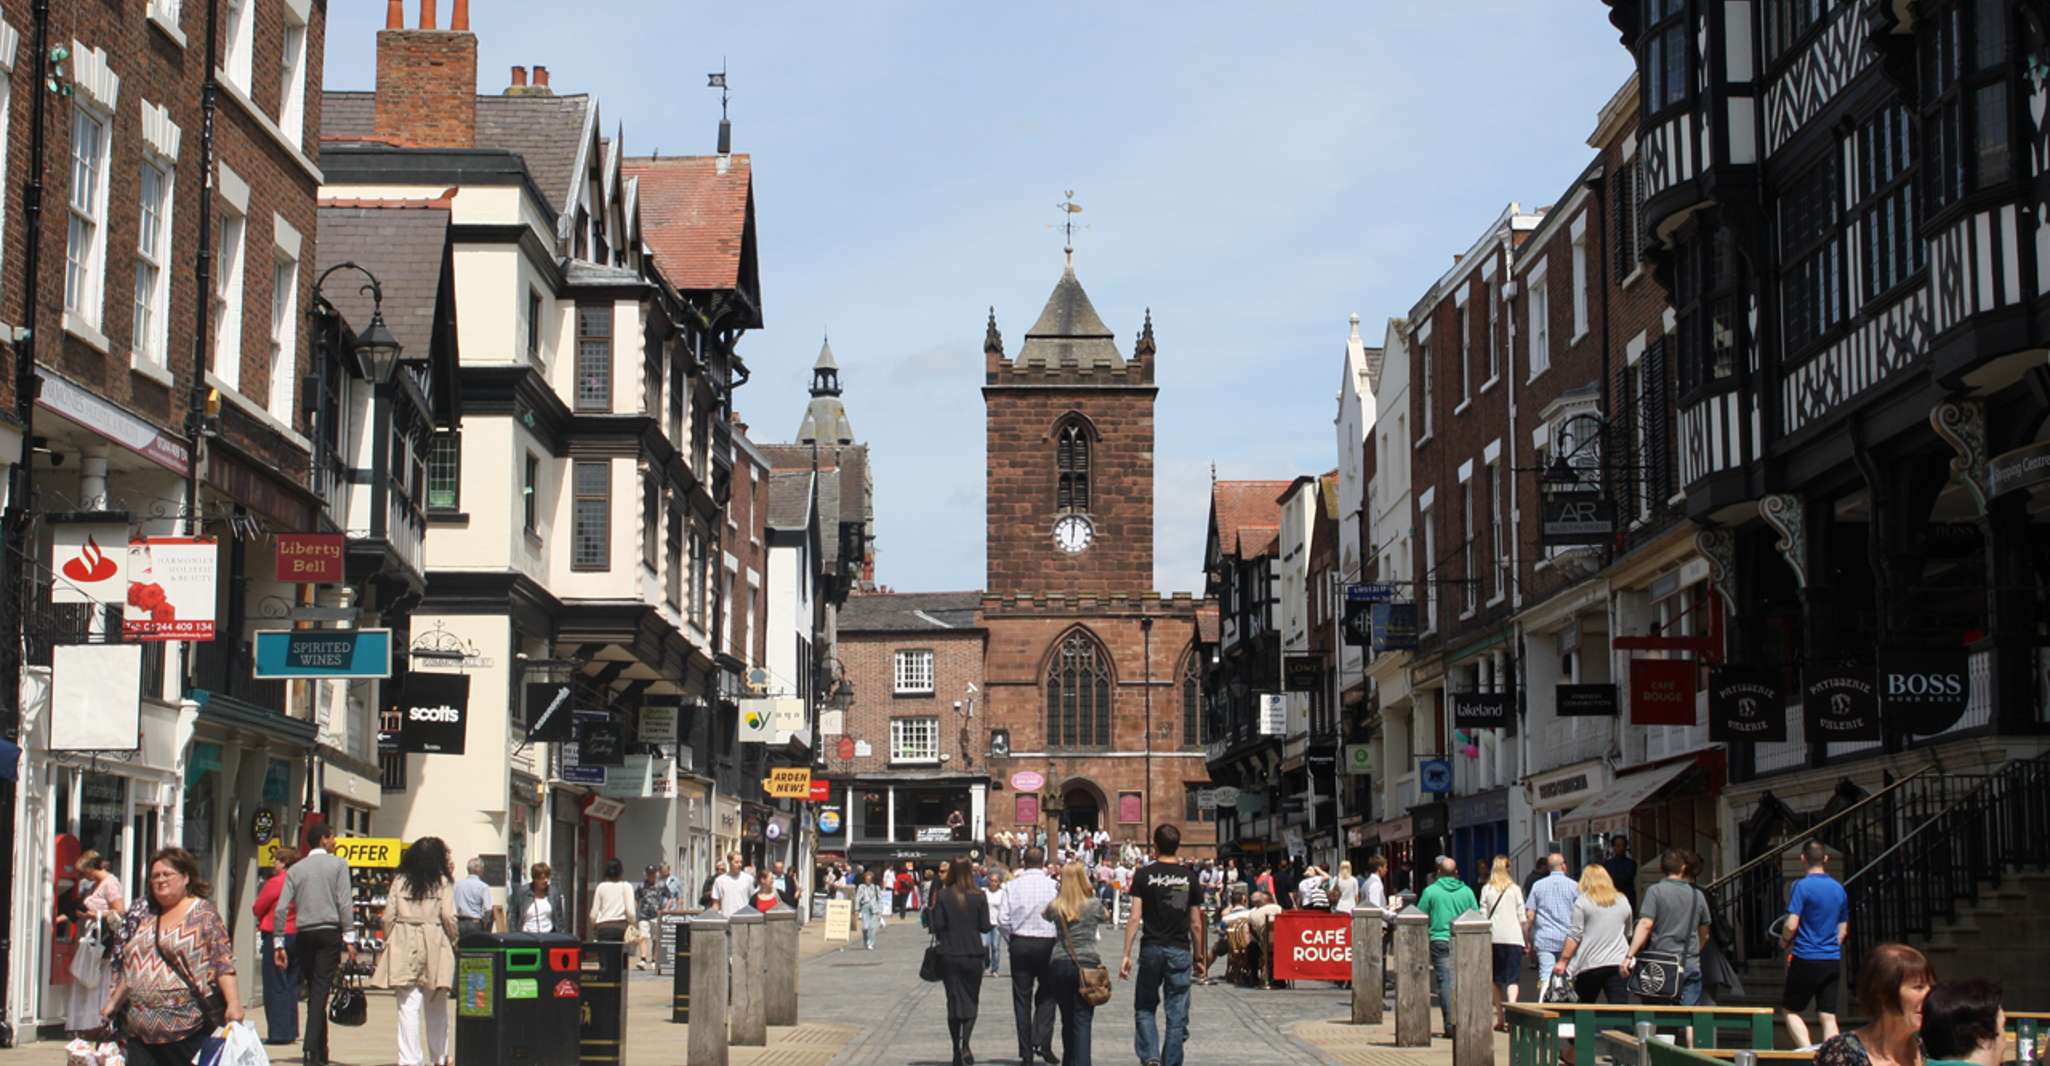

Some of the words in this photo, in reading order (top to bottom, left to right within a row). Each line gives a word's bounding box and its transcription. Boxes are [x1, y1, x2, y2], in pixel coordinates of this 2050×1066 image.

[1559, 503, 1597, 523] AR
[280, 542, 340, 558] Liberty
[293, 560, 325, 573] Bell
[176, 622, 193, 631] 409
[196, 622, 212, 631] 134
[293, 642, 350, 654] SPIRITED
[300, 655, 342, 665] WINES
[1719, 683, 1776, 699] PATISSERIE
[1809, 677, 1872, 695] PATISSERIE
[1887, 673, 1962, 695] BOSS
[1643, 691, 1683, 702] ROUGE
[409, 706, 459, 722] scotts
[1457, 704, 1503, 717] lakeland
[773, 773, 808, 782] ARDEN
[776, 784, 806, 793] NEWS
[335, 844, 389, 861] OFFER
[1301, 927, 1347, 944] CAFÉ
[1293, 947, 1352, 962] ROUGE
